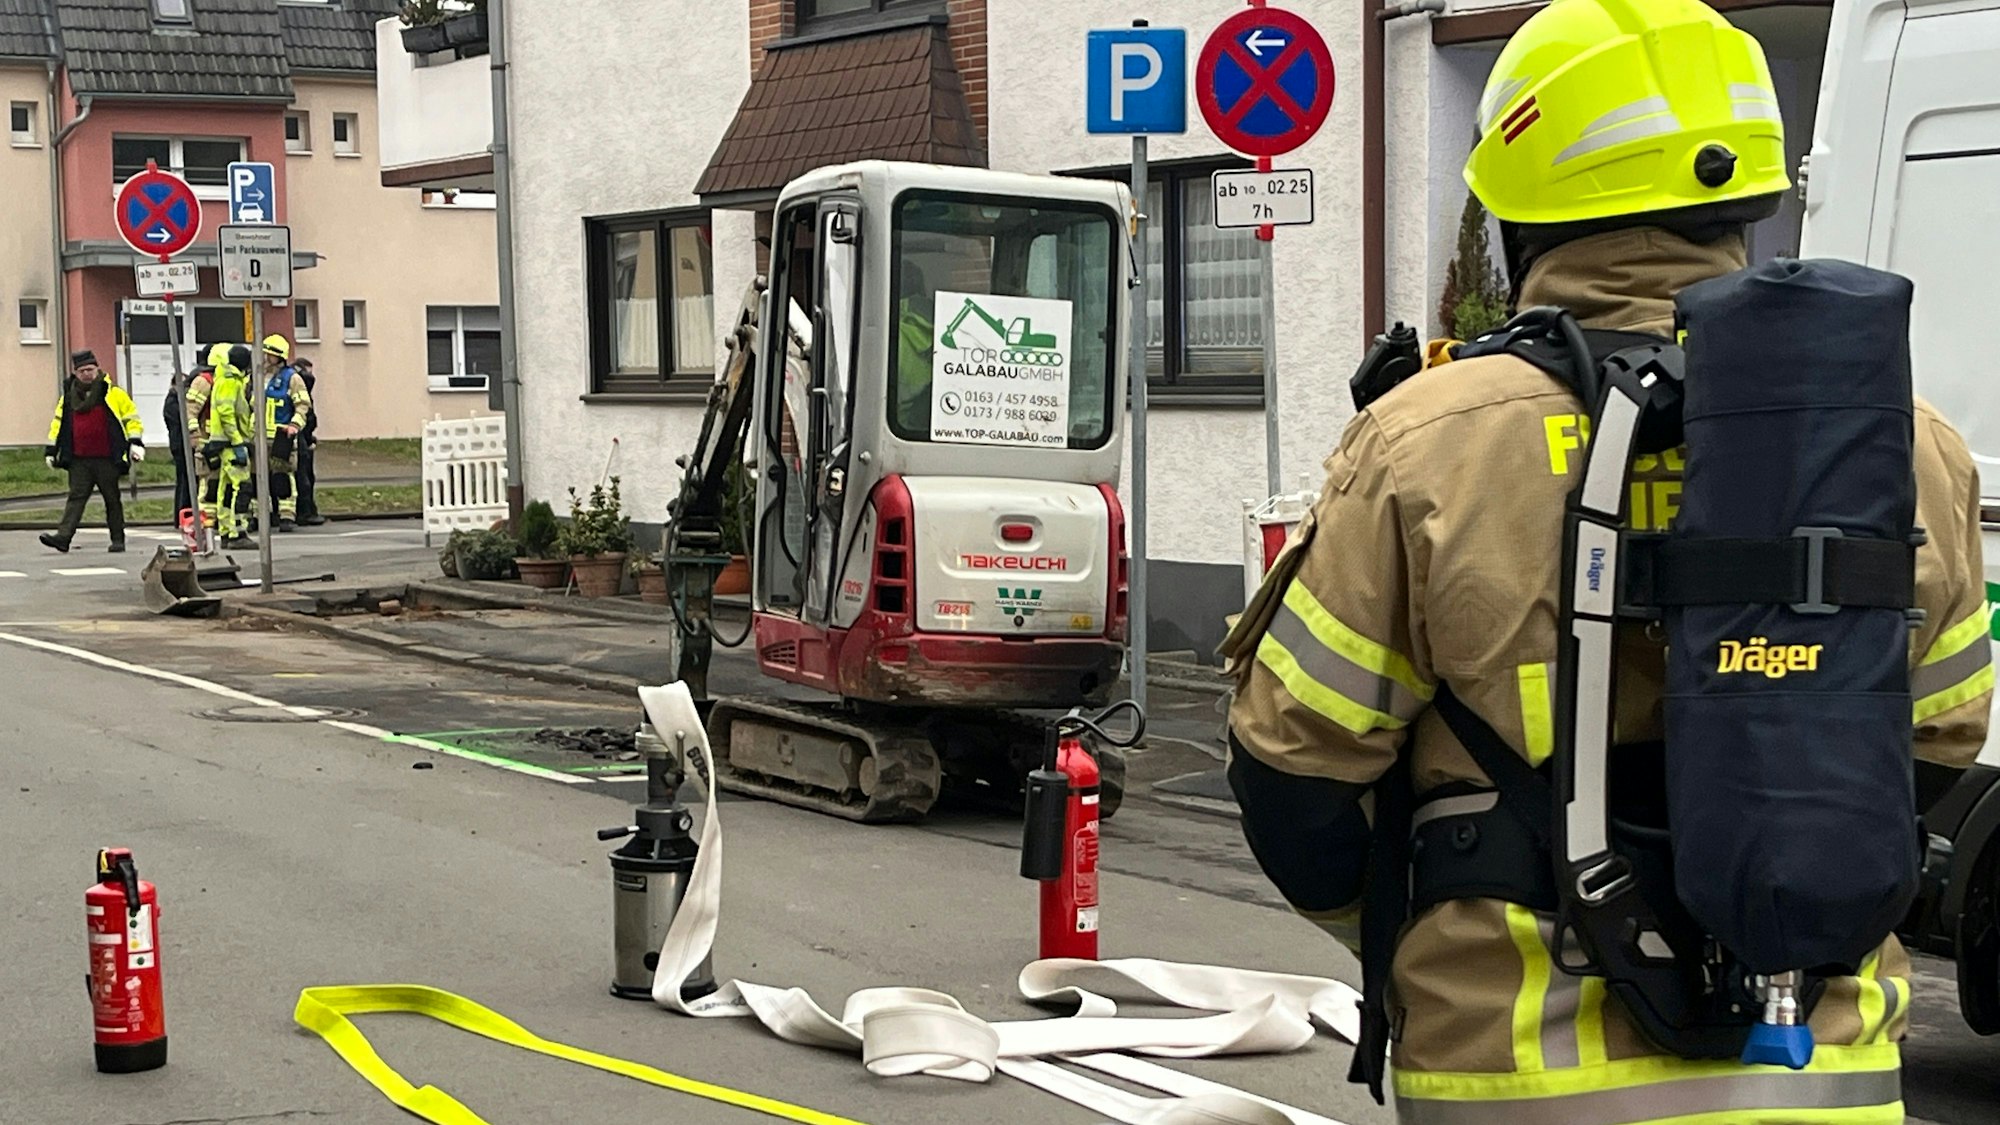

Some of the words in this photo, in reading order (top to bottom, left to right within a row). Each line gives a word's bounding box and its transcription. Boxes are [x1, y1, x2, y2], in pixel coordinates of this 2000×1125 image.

[1110, 43, 1163, 121] P
[234, 169, 255, 202] P
[1218, 182, 1238, 197] ab
[235, 233, 271, 241] Bewohner
[224, 245, 237, 254] mit
[240, 244, 286, 254] Parkausweis
[140, 269, 151, 278] ab
[250, 259, 261, 278] D
[964, 390, 993, 403] 0163
[1004, 394, 1026, 404] 457
[963, 405, 992, 418] 0173
[1004, 408, 1025, 420] 988
[1586, 547, 1606, 592] Dräger
[1717, 636, 1824, 679] Dräger
